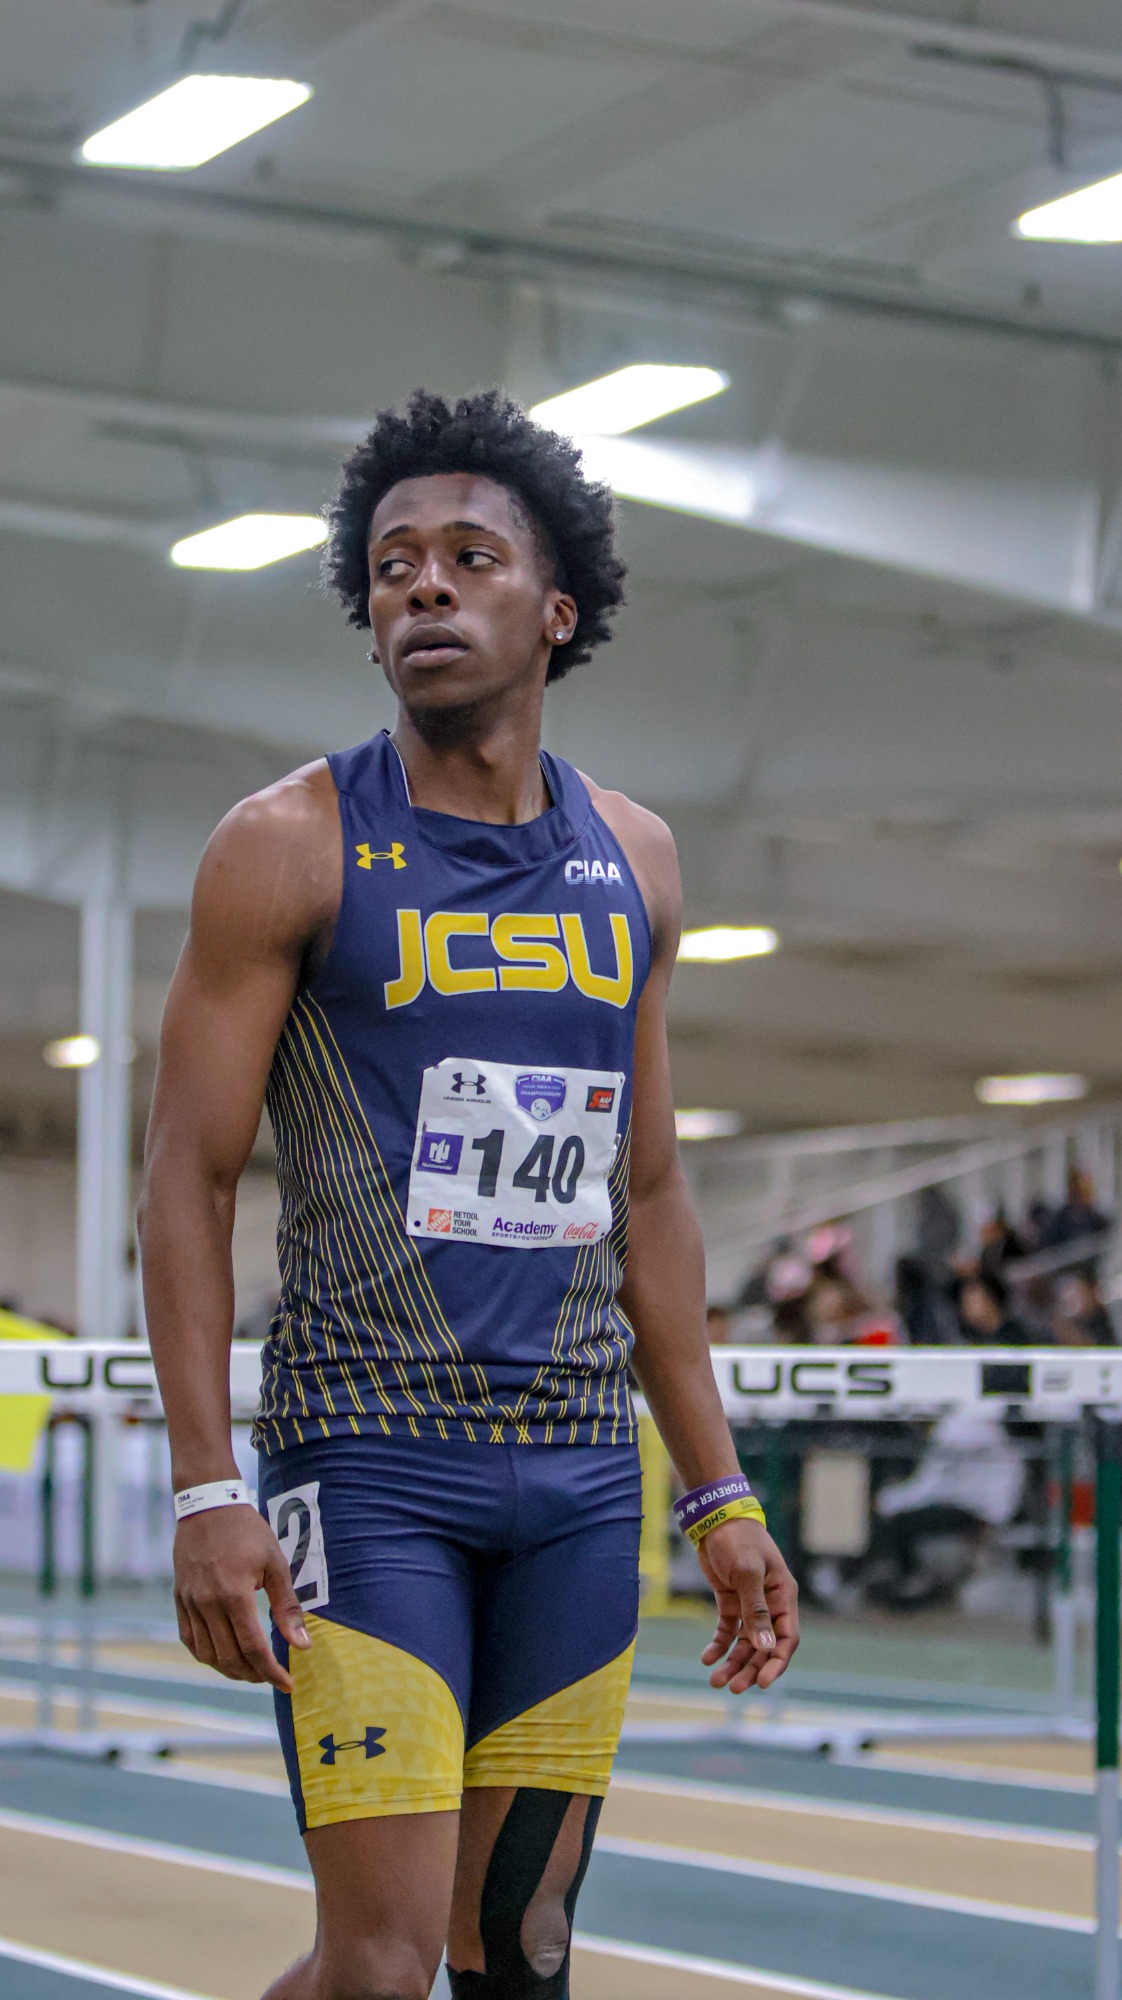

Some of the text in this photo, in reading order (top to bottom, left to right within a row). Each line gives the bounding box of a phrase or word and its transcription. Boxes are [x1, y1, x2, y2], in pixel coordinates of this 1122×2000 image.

[564, 859, 625, 887] CIAA
[383, 908, 634, 1011] JCSU
[421, 1162, 453, 1171] Nationwide
[472, 1129, 585, 1204] 140
[453, 1210, 480, 1221] RETOOL
[453, 1218, 472, 1228] YOUR
[492, 1217, 557, 1239] Academy
[452, 1226, 479, 1237] SCHOOL
[40, 1355, 154, 1389] UC
[732, 1361, 893, 1395] UCS
[699, 1482, 743, 1506] FOREVER
[696, 1508, 727, 1535] SHOW
[277, 1496, 318, 1604] 2
